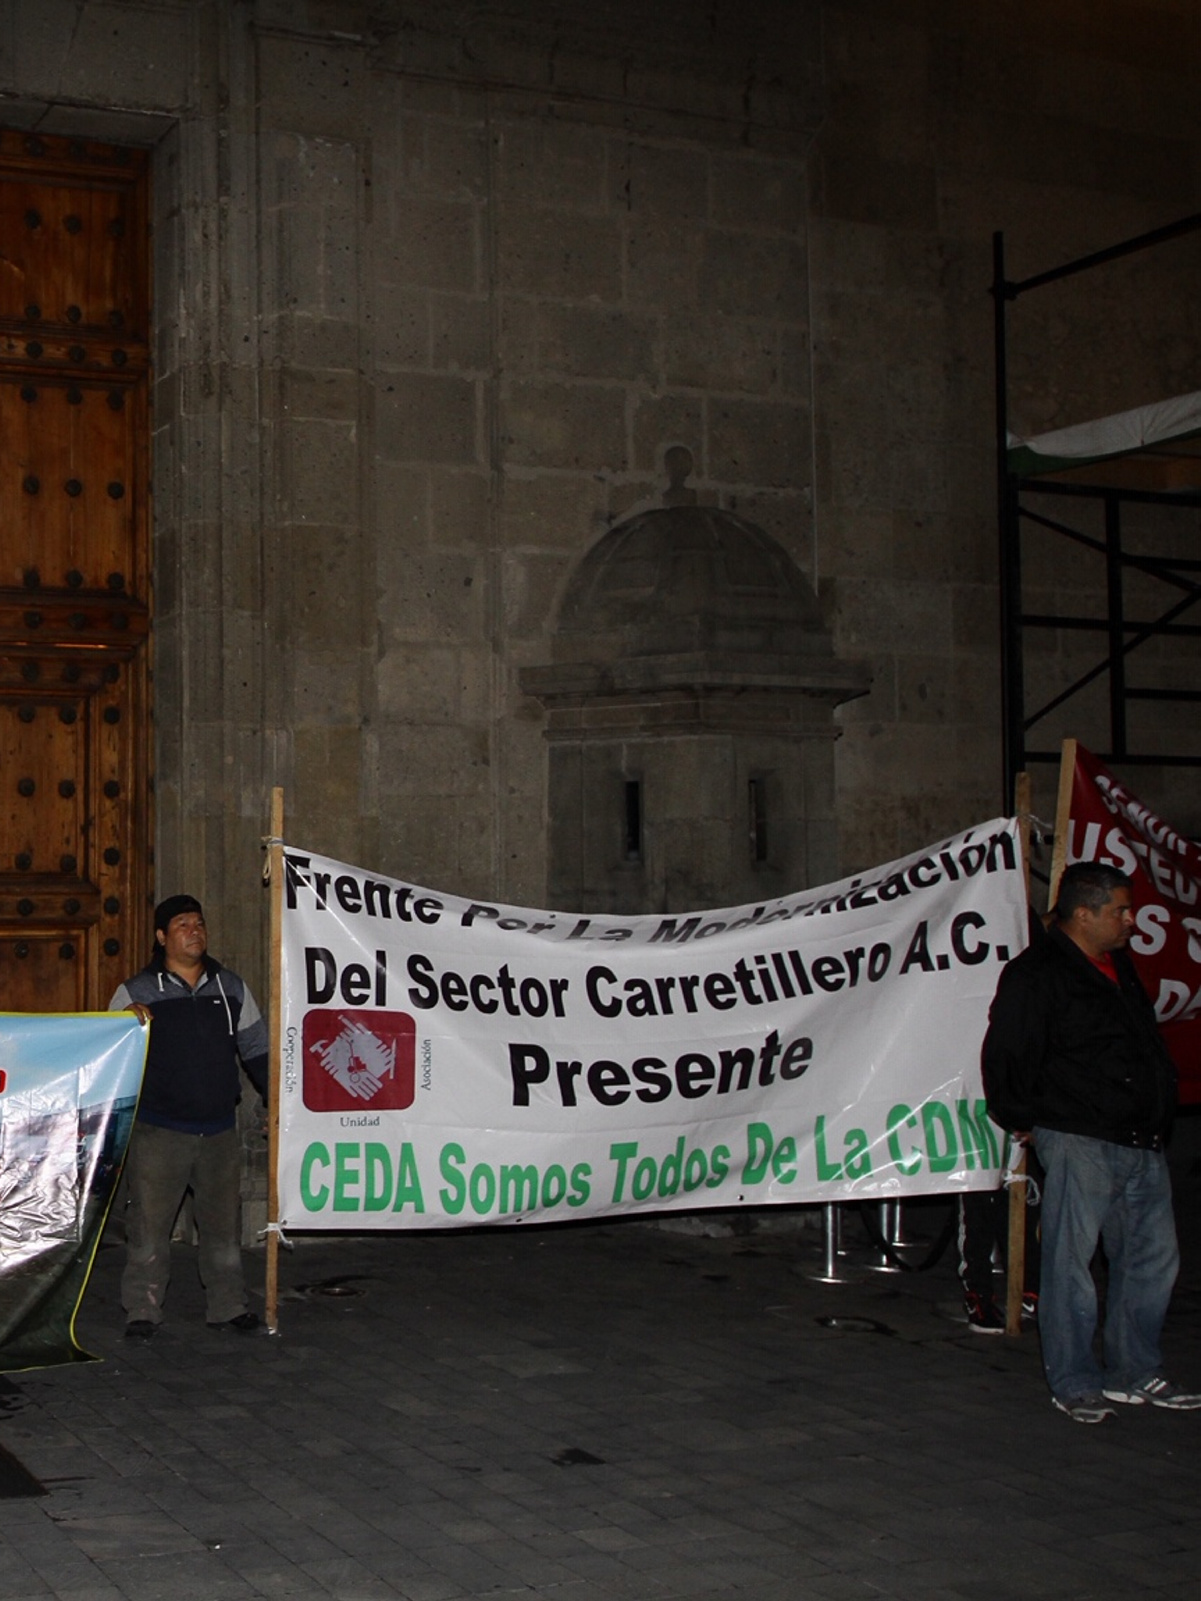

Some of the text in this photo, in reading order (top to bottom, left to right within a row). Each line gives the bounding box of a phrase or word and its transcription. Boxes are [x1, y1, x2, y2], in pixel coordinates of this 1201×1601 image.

[284, 829, 1016, 944] Frente Por La Modernización
[304, 910, 1010, 1018] Del Sector Carretillero A.C.
[283, 1026, 297, 1093] Cooperación
[421, 1039, 432, 1091] Asociación
[508, 1029, 814, 1107] Presente
[301, 1099, 1011, 1215] CEDA Somos Todos De La CDM
[340, 1116, 380, 1127] Unidad
